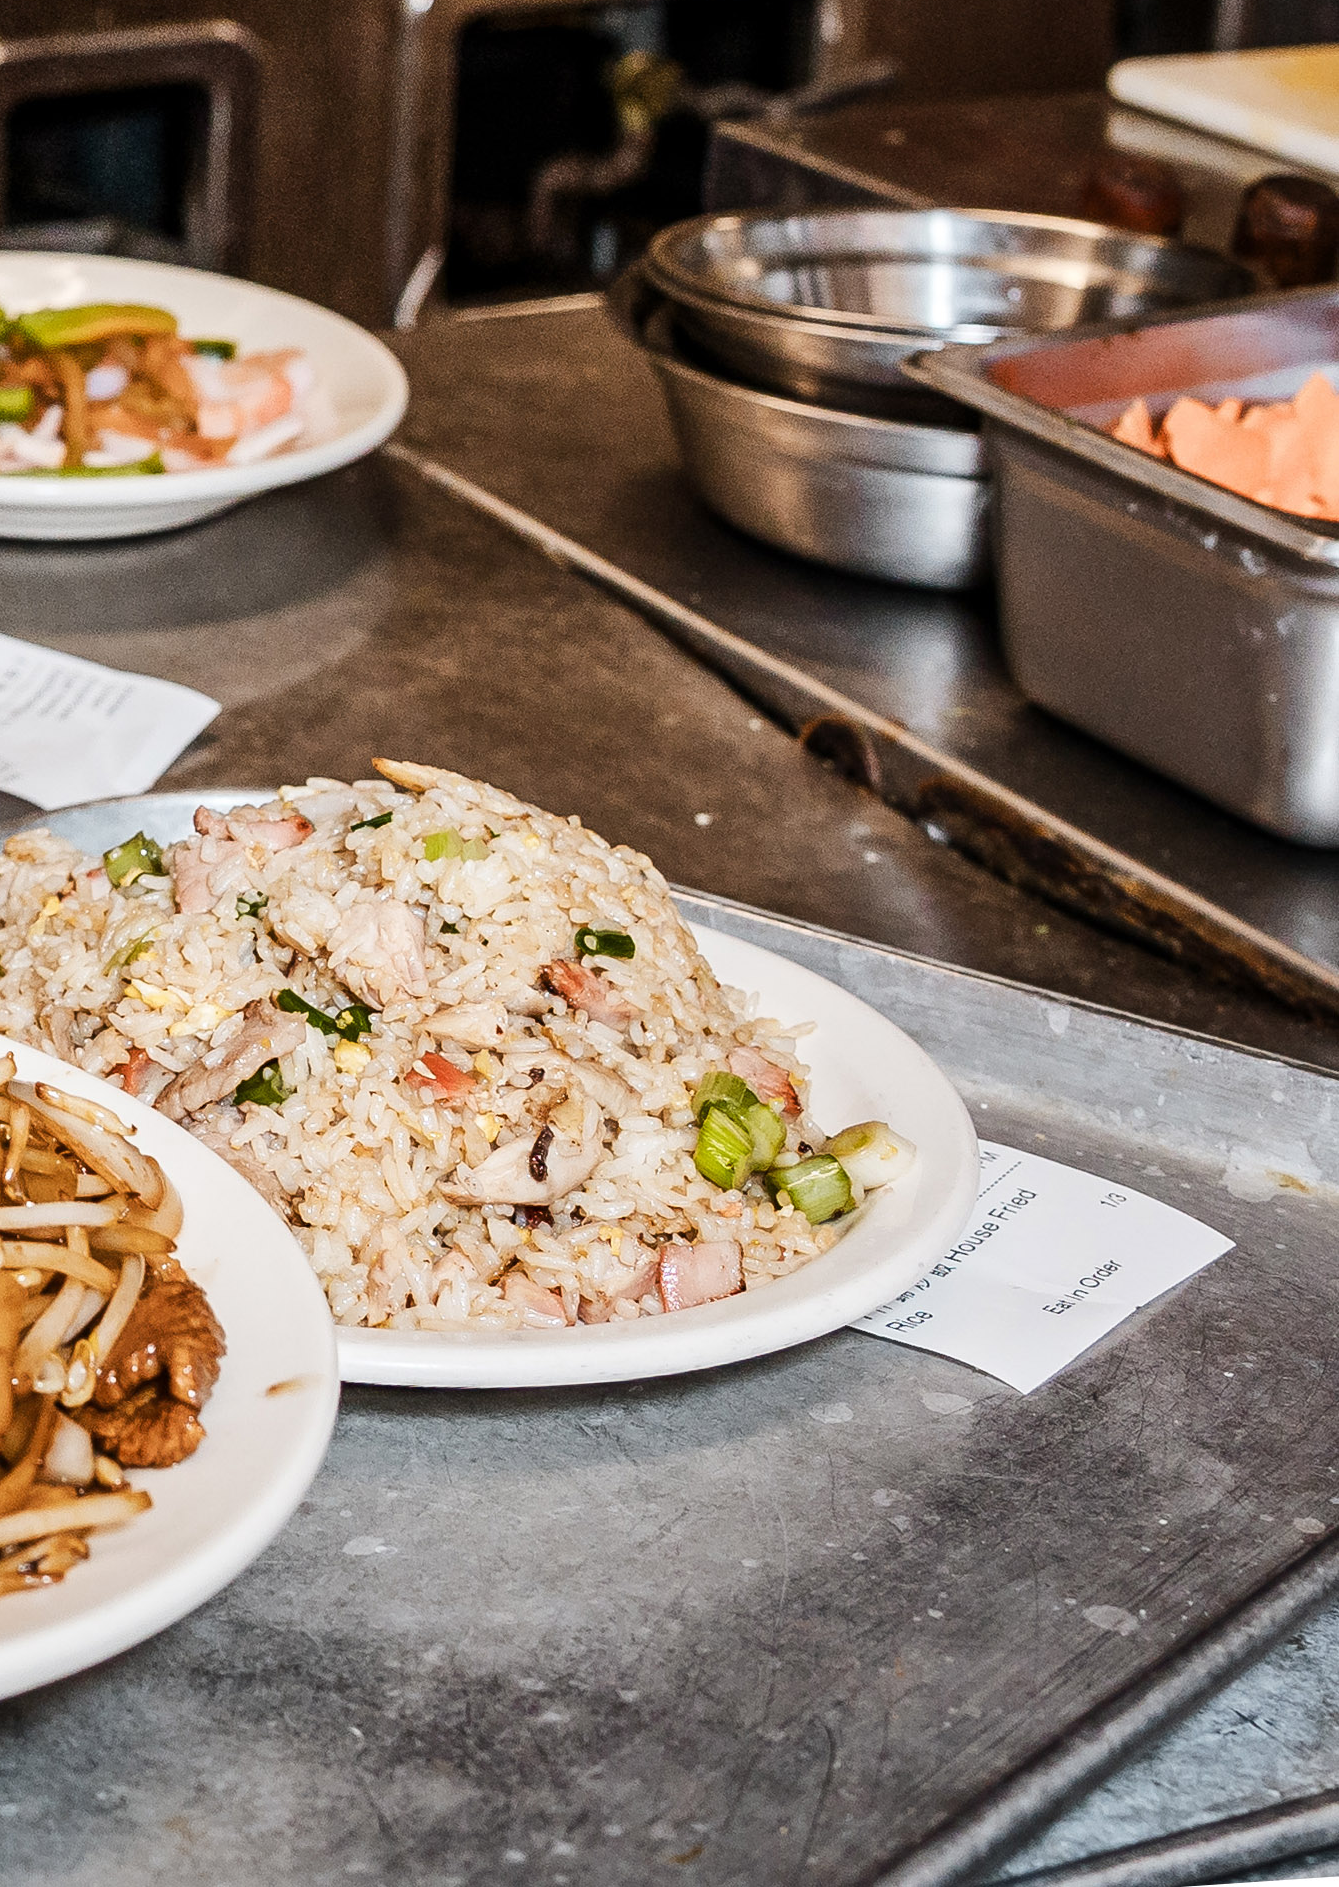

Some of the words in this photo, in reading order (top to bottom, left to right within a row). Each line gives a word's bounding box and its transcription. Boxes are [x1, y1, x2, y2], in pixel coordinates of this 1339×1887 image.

[1100, 1192, 1127, 1208] 1/3
[944, 1221, 1000, 1263] House
[988, 1188, 1039, 1221] Fried
[1042, 1299, 1076, 1315] Eat
[1064, 1288, 1089, 1301] In
[1079, 1259, 1122, 1289] Order
[886, 1310, 933, 1333] Rice
